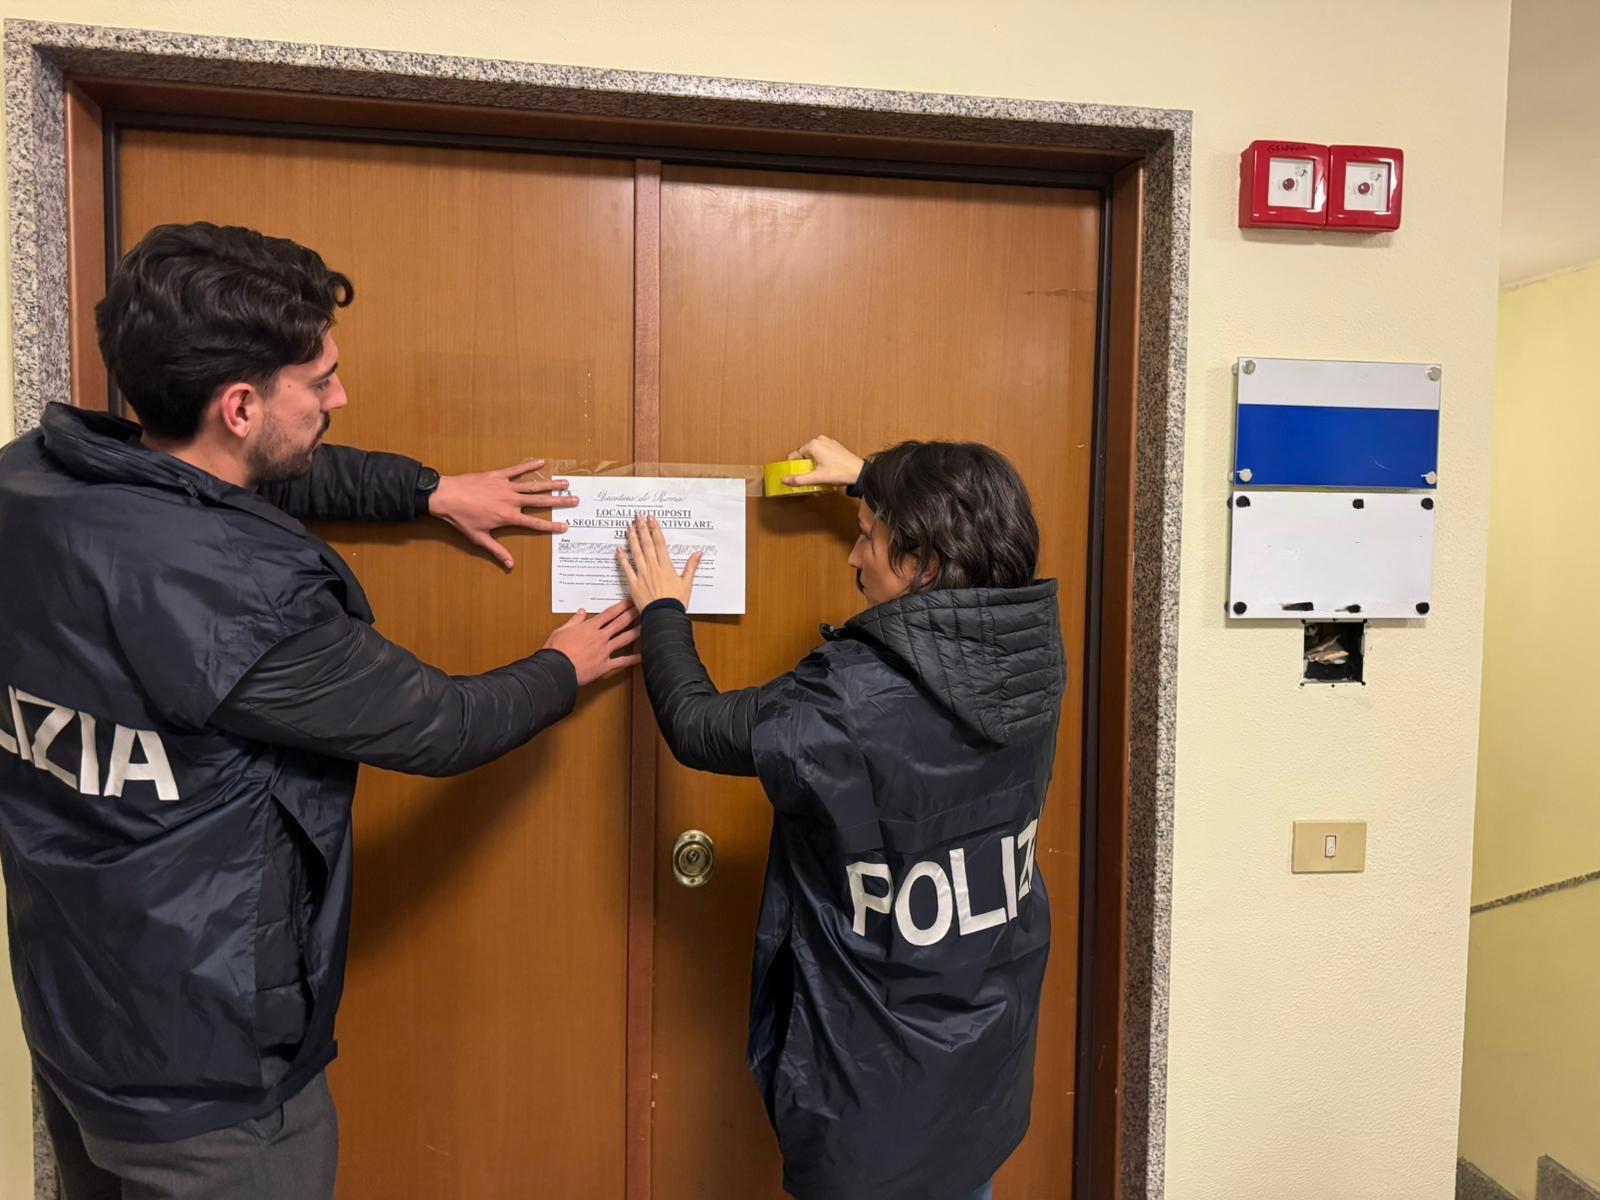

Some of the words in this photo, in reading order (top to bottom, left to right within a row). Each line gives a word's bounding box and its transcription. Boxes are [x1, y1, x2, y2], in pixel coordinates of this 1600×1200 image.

[595, 509, 632, 517] LOCALI
[633, 509, 692, 517] SOTTOPOSTI
[564, 519, 571, 527] A
[572, 519, 629, 528] SEQUESTRO
[845, 818, 1038, 946] POLIZ
